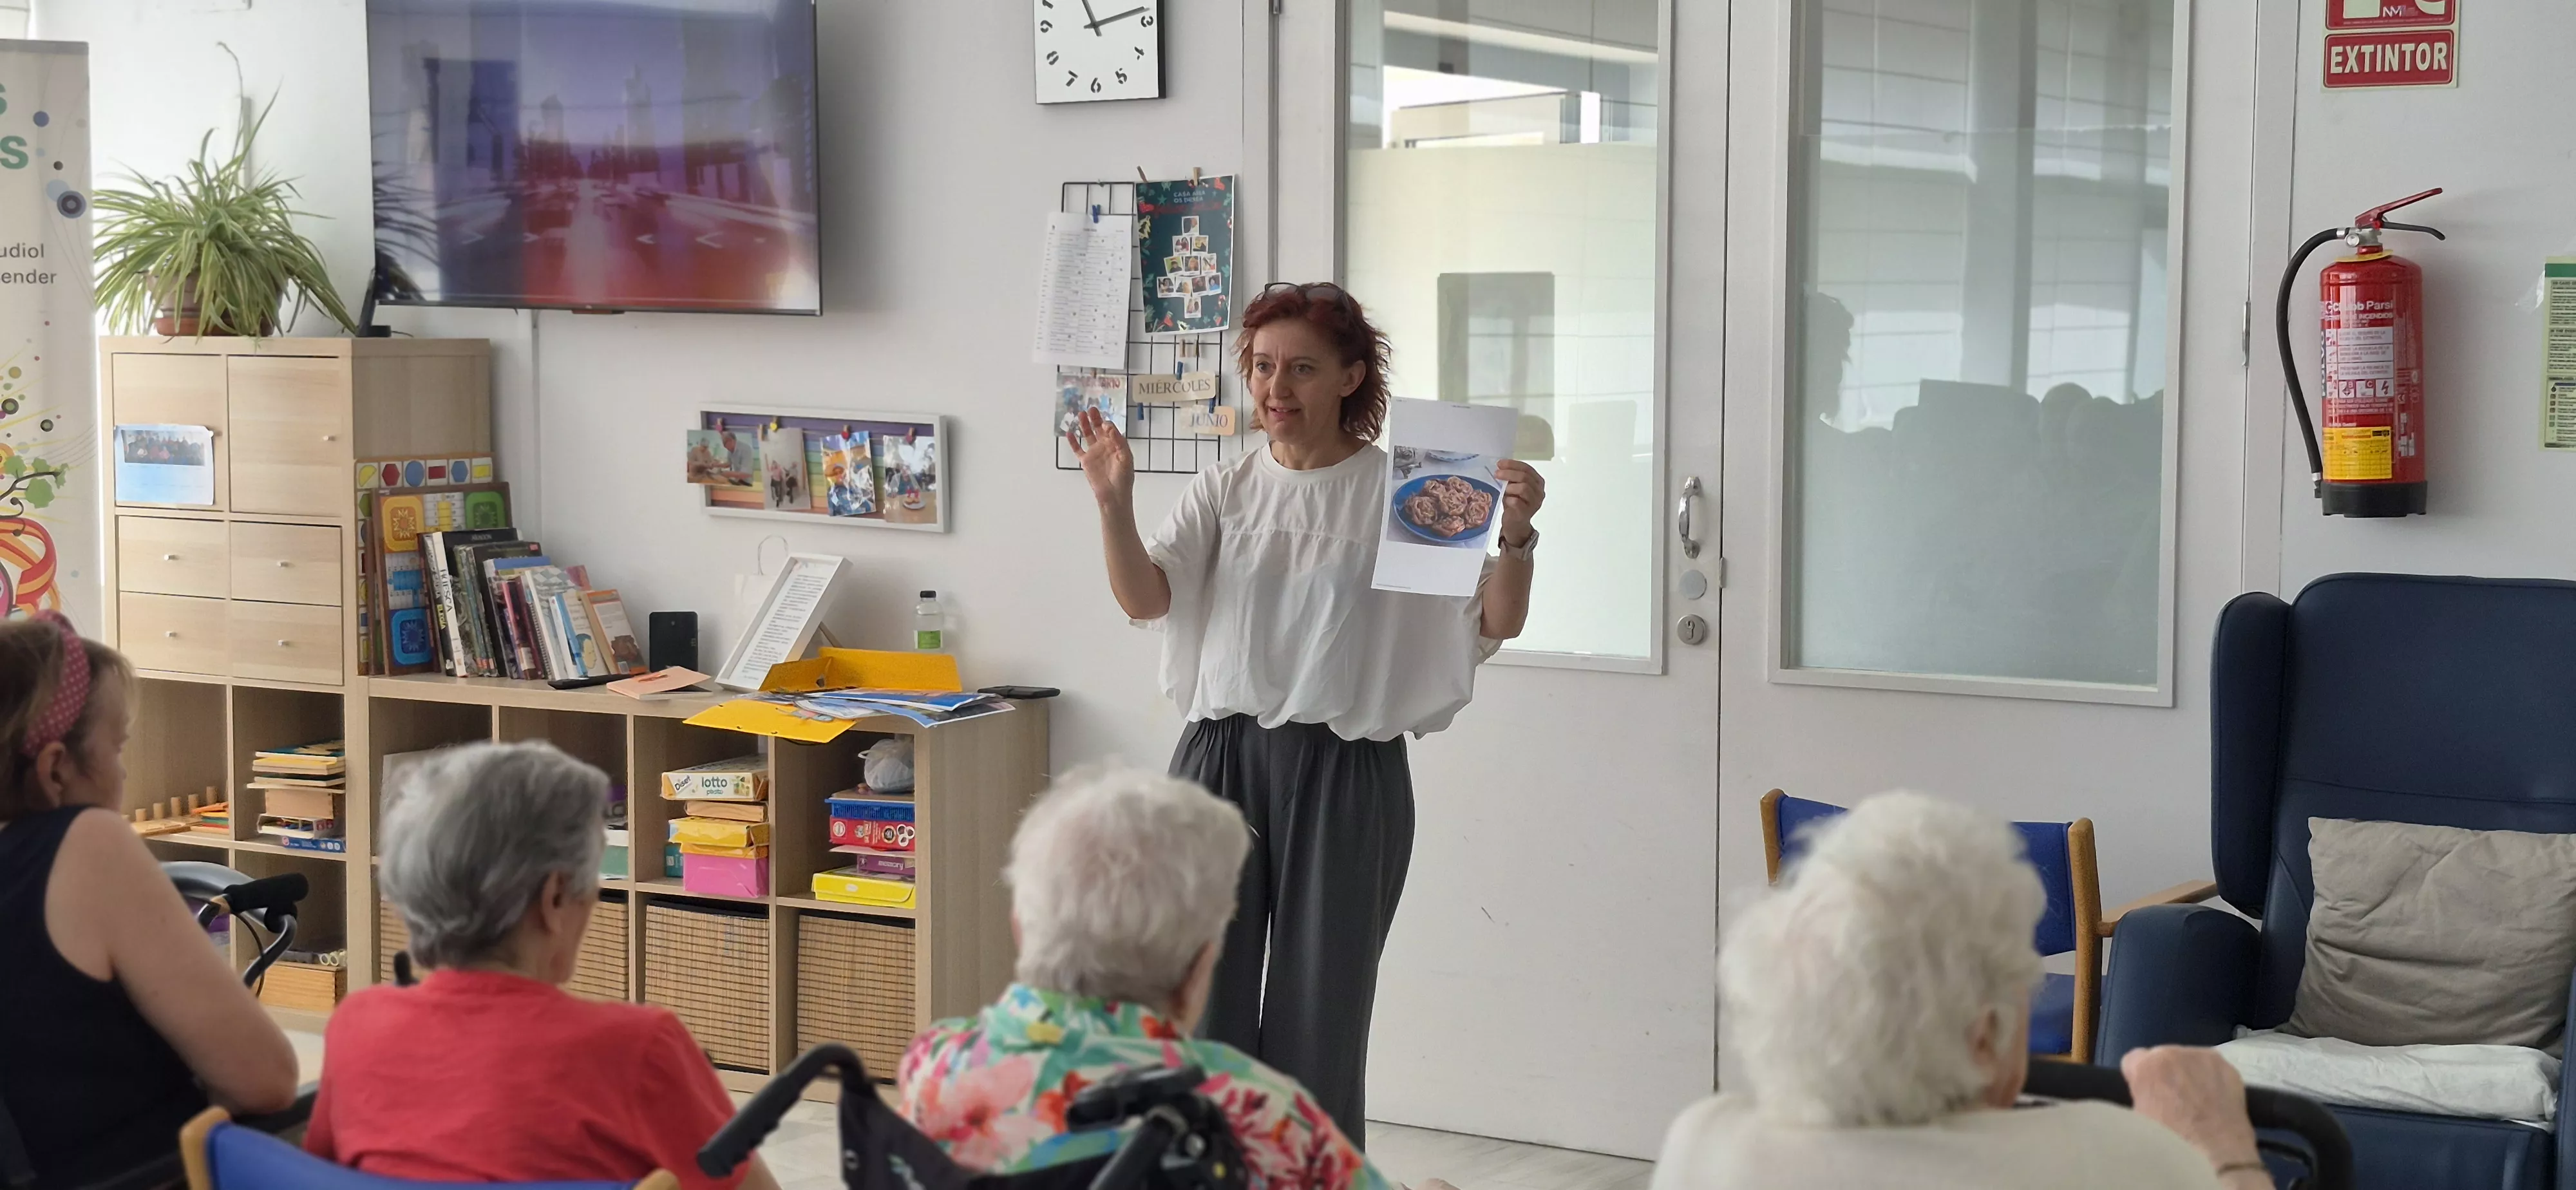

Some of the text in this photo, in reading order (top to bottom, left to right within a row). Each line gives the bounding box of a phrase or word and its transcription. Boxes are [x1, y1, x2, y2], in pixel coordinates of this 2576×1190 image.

[1040, 20, 1053, 33] 9
[1141, 15, 1153, 28] 3
[2329, 42, 2448, 74] EXTINTOR
[1065, 70, 1079, 87] 7
[1115, 68, 1128, 84] 5
[1090, 77, 1101, 93] 6
[2366, 300, 2393, 310] Parsi
[1139, 379, 1211, 395] MIÉRCOLES
[1189, 413, 1228, 429] JUNIO
[701, 776, 728, 788] lotto
[878, 860, 904, 871] memory
